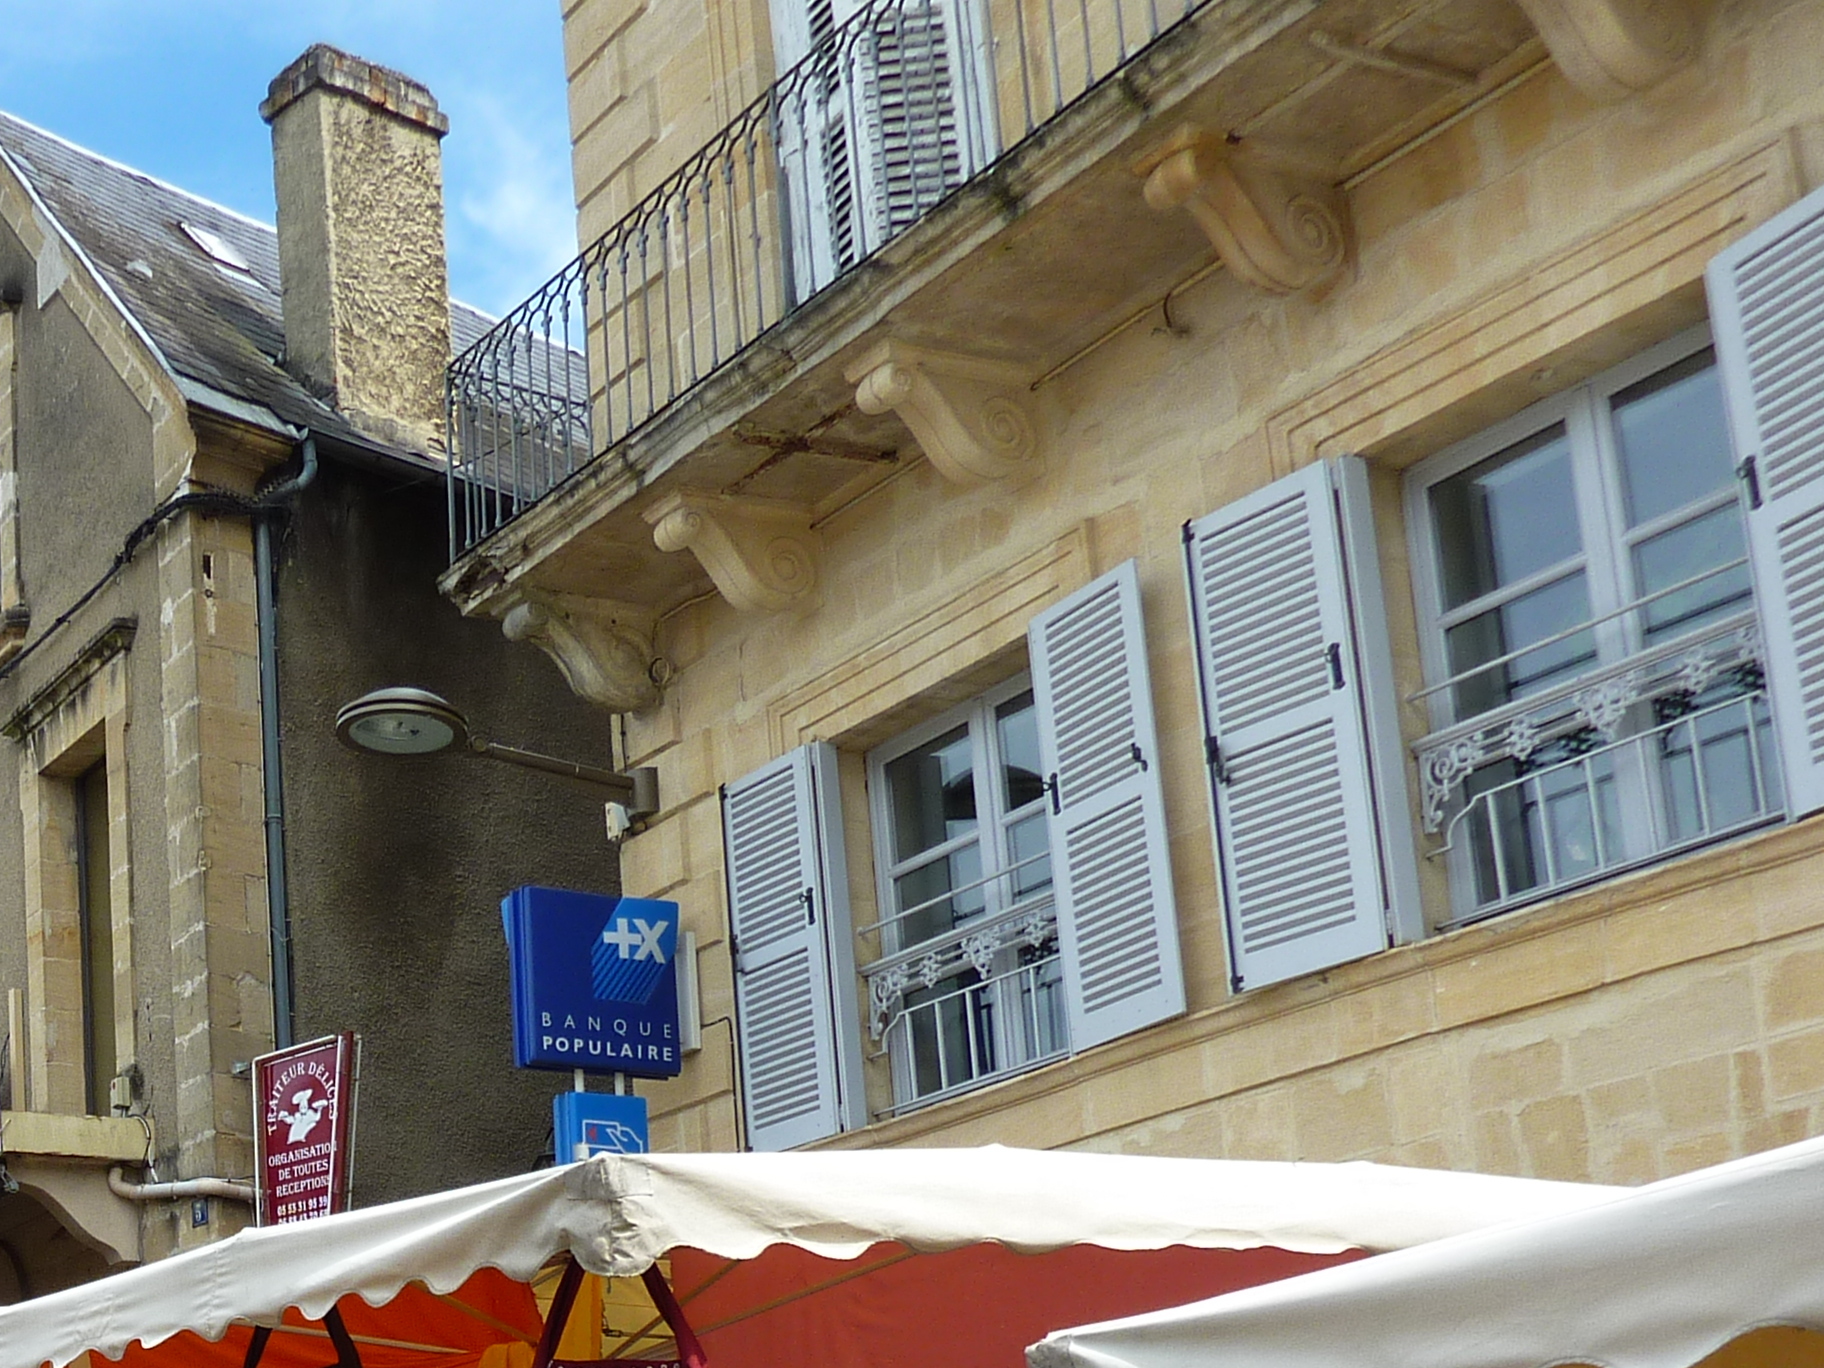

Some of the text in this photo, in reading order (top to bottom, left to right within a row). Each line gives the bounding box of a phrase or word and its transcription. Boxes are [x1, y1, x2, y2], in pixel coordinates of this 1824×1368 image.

[542, 1011, 672, 1039] BANQUE
[542, 1035, 673, 1062] POPULAIRE
[267, 1061, 305, 1136] TRAITEUR
[278, 1159, 329, 1181] DE TOUTES
